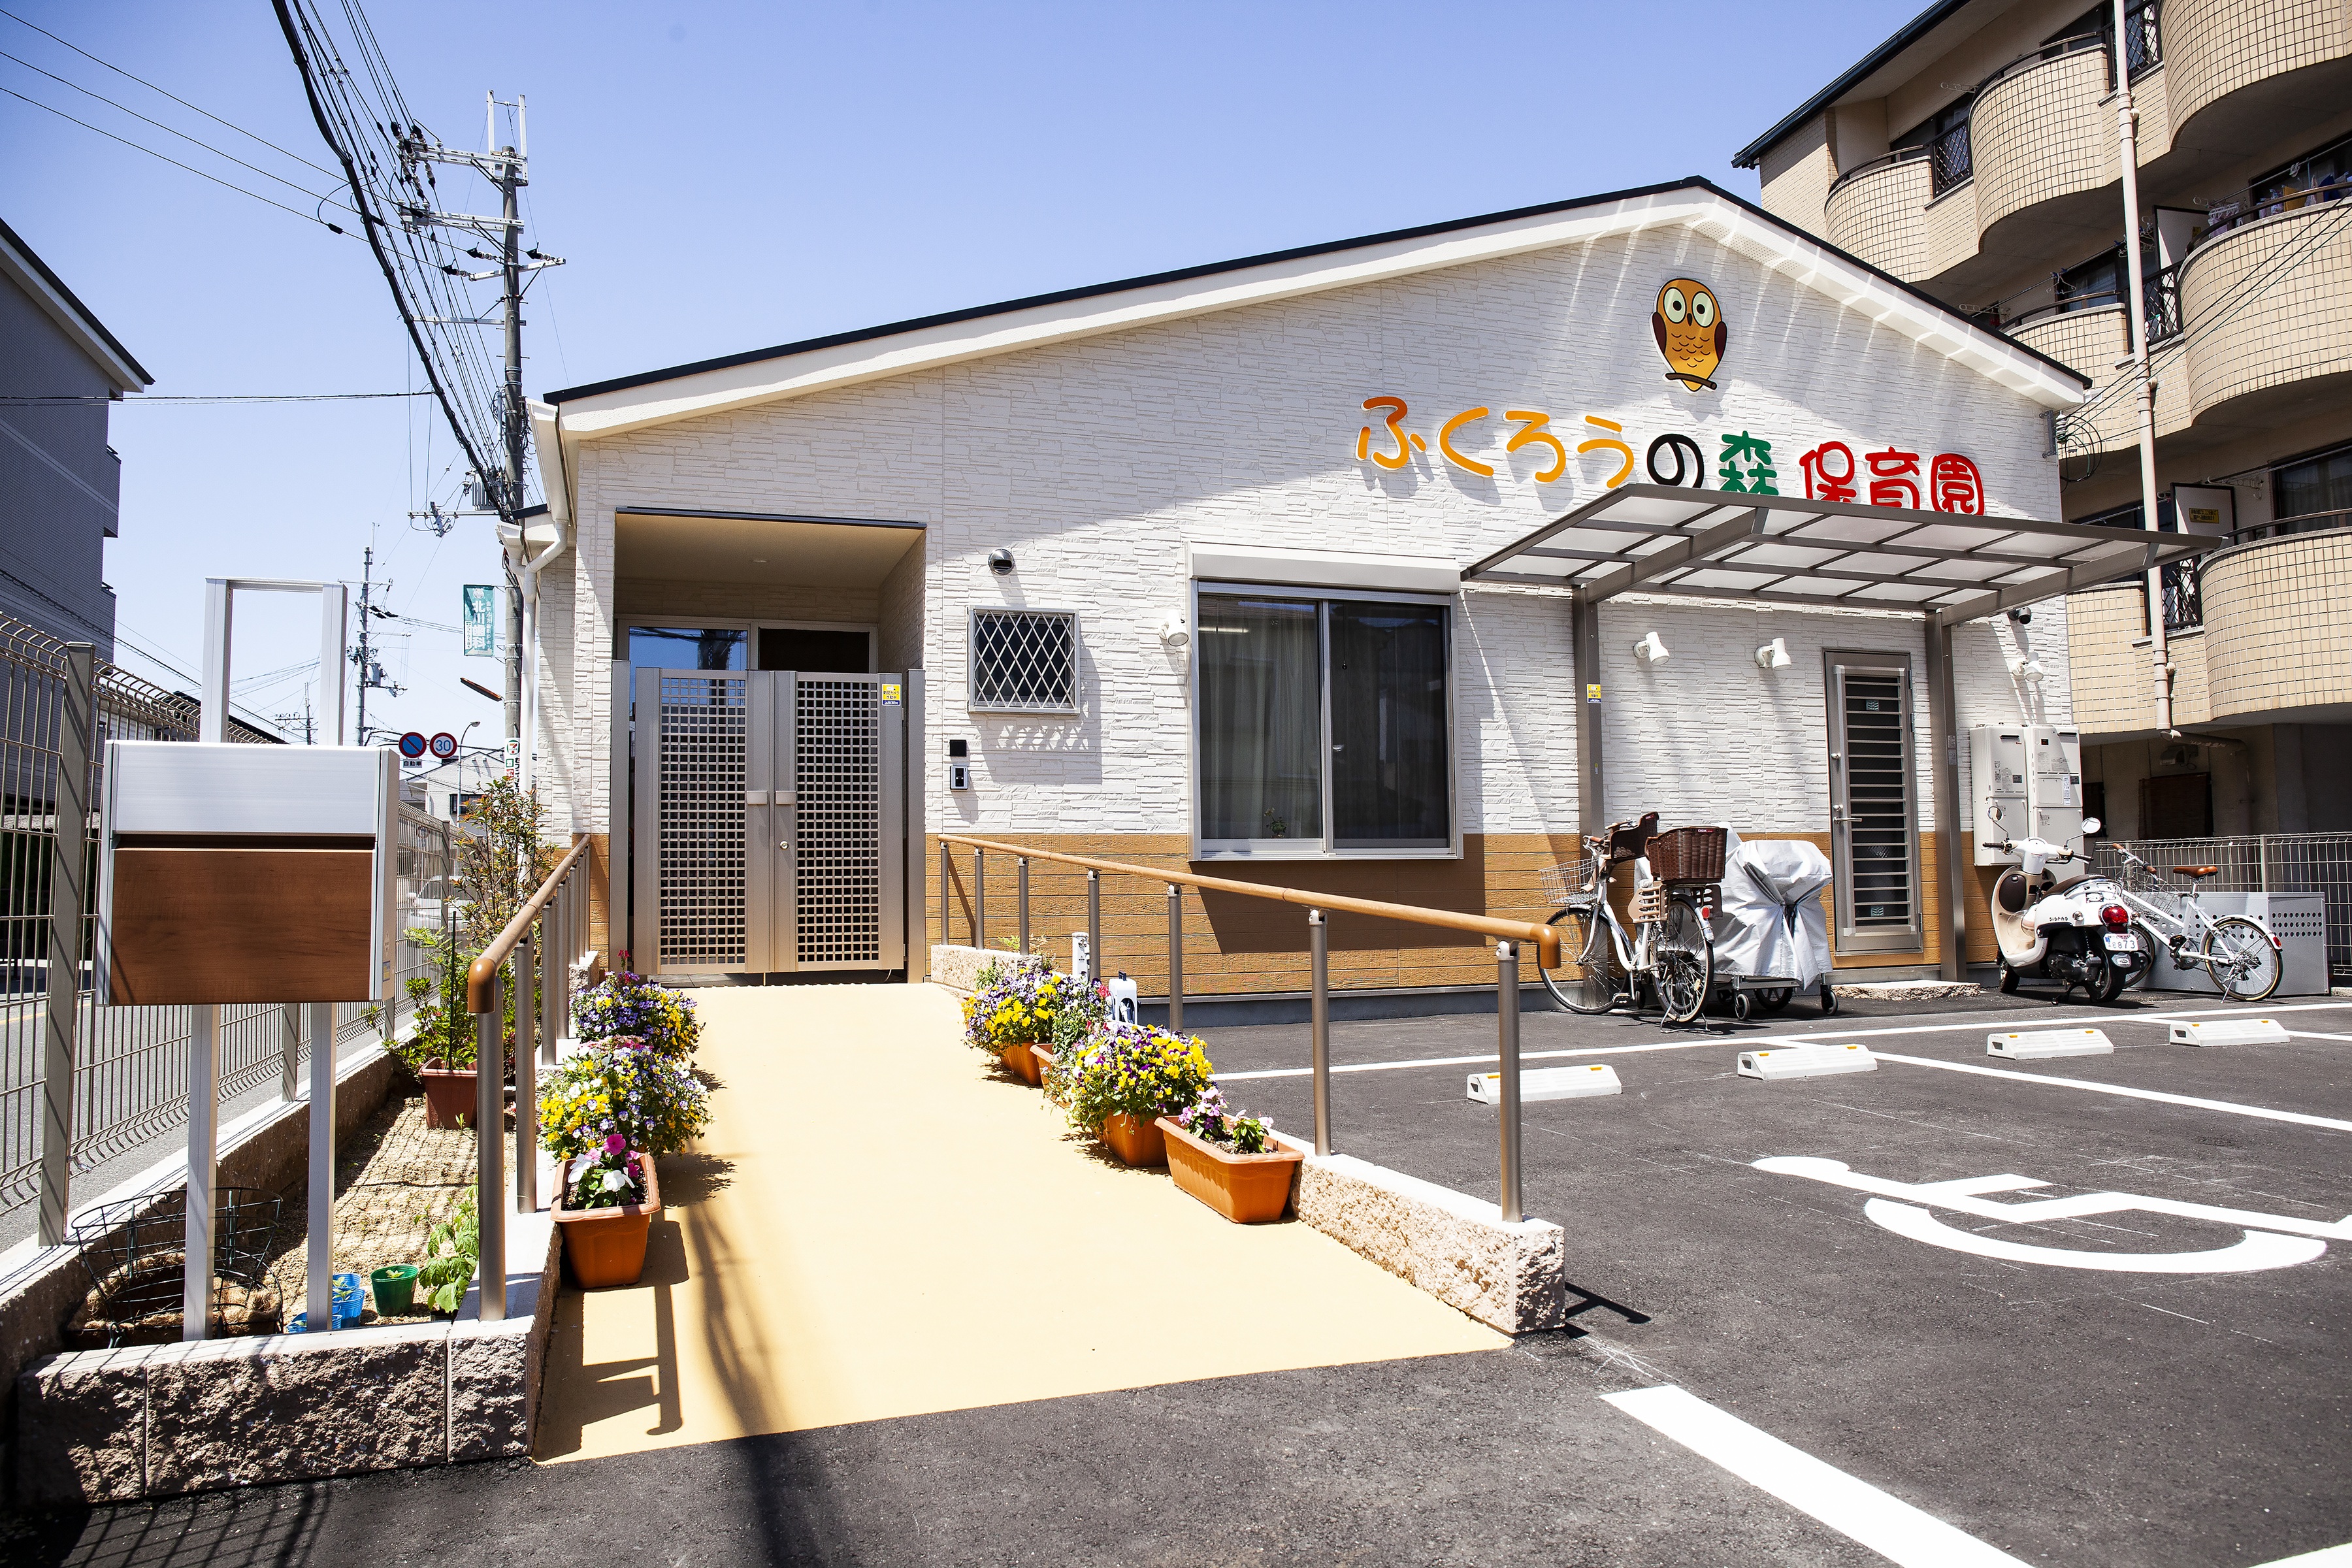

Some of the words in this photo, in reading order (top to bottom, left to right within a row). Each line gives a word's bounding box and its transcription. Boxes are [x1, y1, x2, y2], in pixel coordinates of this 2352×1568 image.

[1357, 395, 1984, 516] ふくろうの森保育園
[472, 600, 486, 649] 北川歯科
[436, 740, 451, 751] 30
[2112, 940, 2135, 949] 8873
